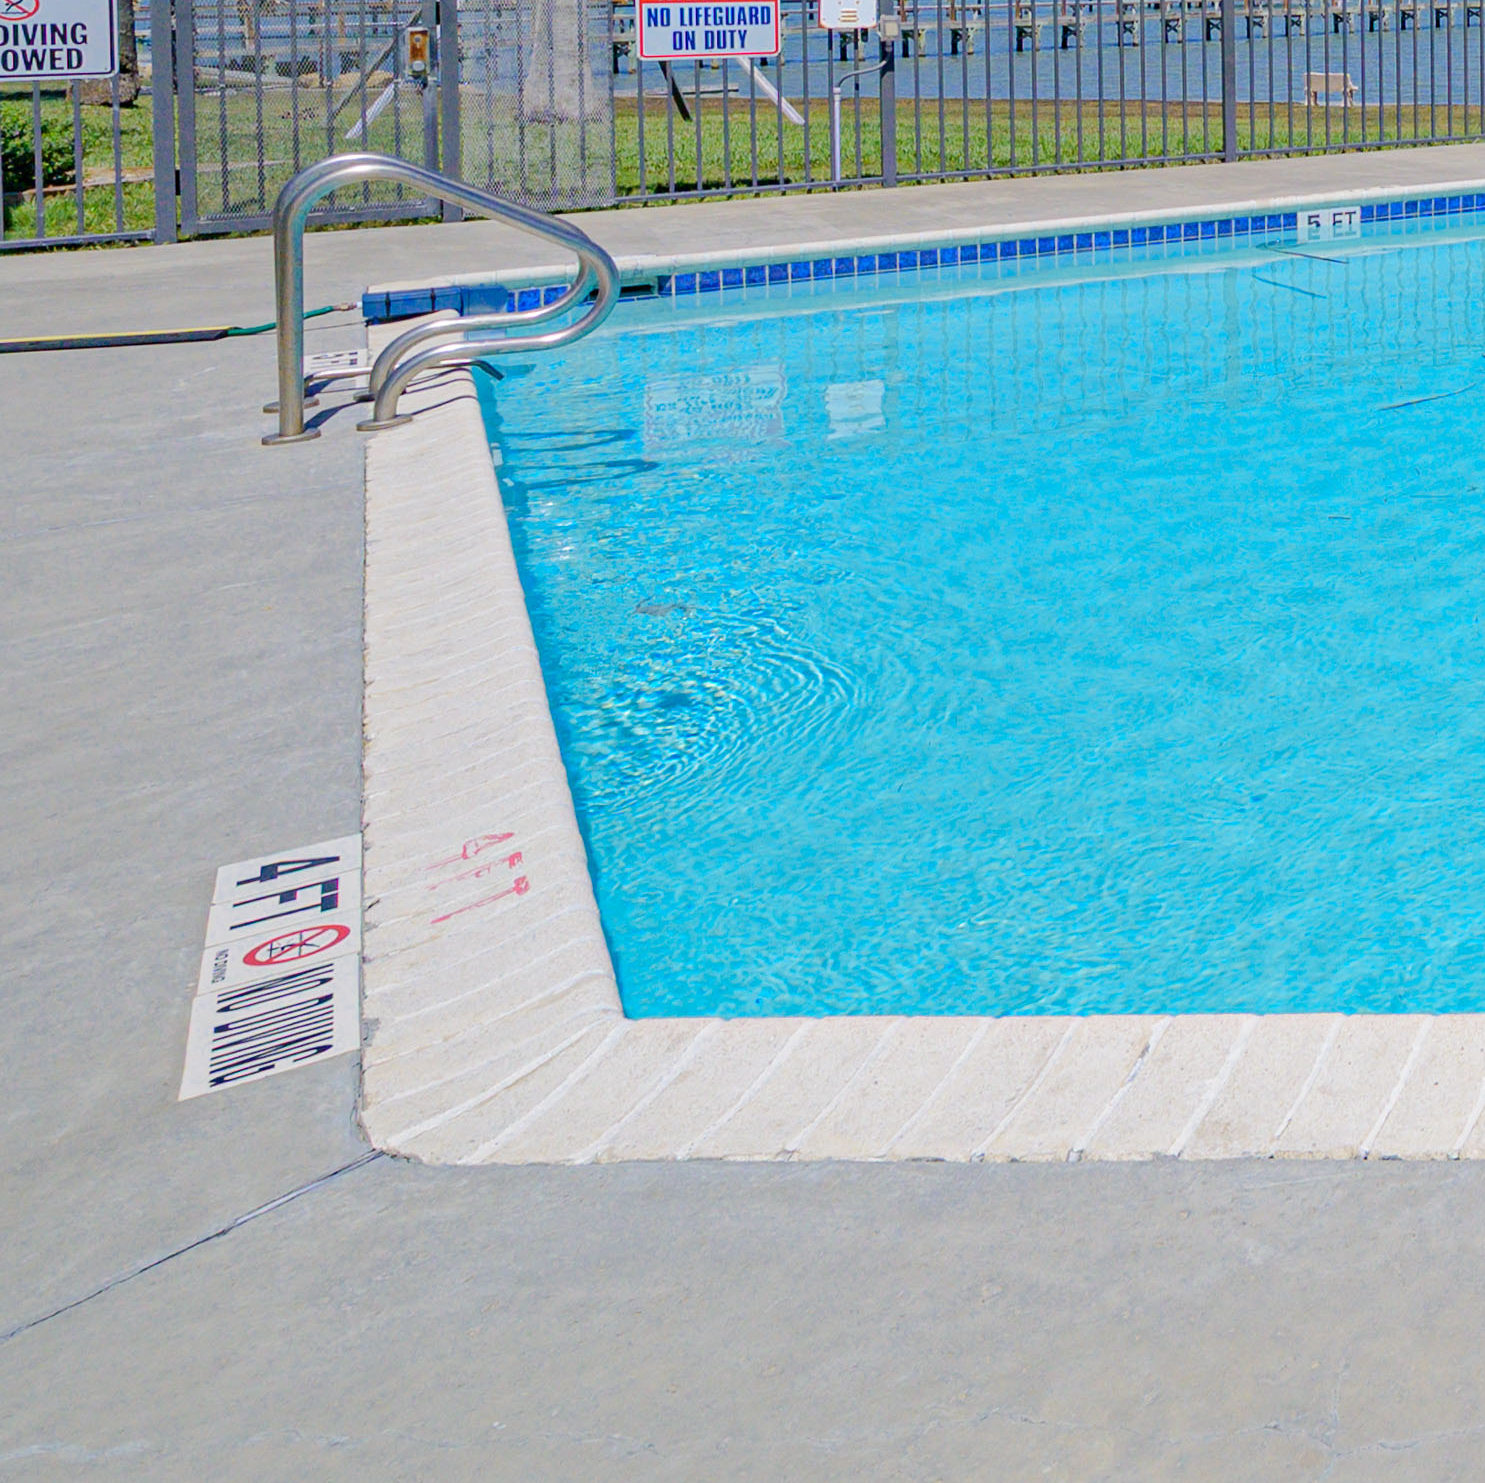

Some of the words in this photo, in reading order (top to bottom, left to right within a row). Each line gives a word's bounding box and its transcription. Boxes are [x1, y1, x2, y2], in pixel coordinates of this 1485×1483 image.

[647, 7, 671, 27] NO
[680, 5, 771, 26] LIFEGUARD
[672, 30, 696, 50] ON
[704, 29, 748, 50] DUTY
[1308, 214, 1320, 227] 5
[1333, 210, 1356, 226] FT
[236, 856, 340, 887] 4
[229, 877, 339, 931] FT
[216, 963, 334, 1013] NO
[209, 993, 334, 1088] DIVING
